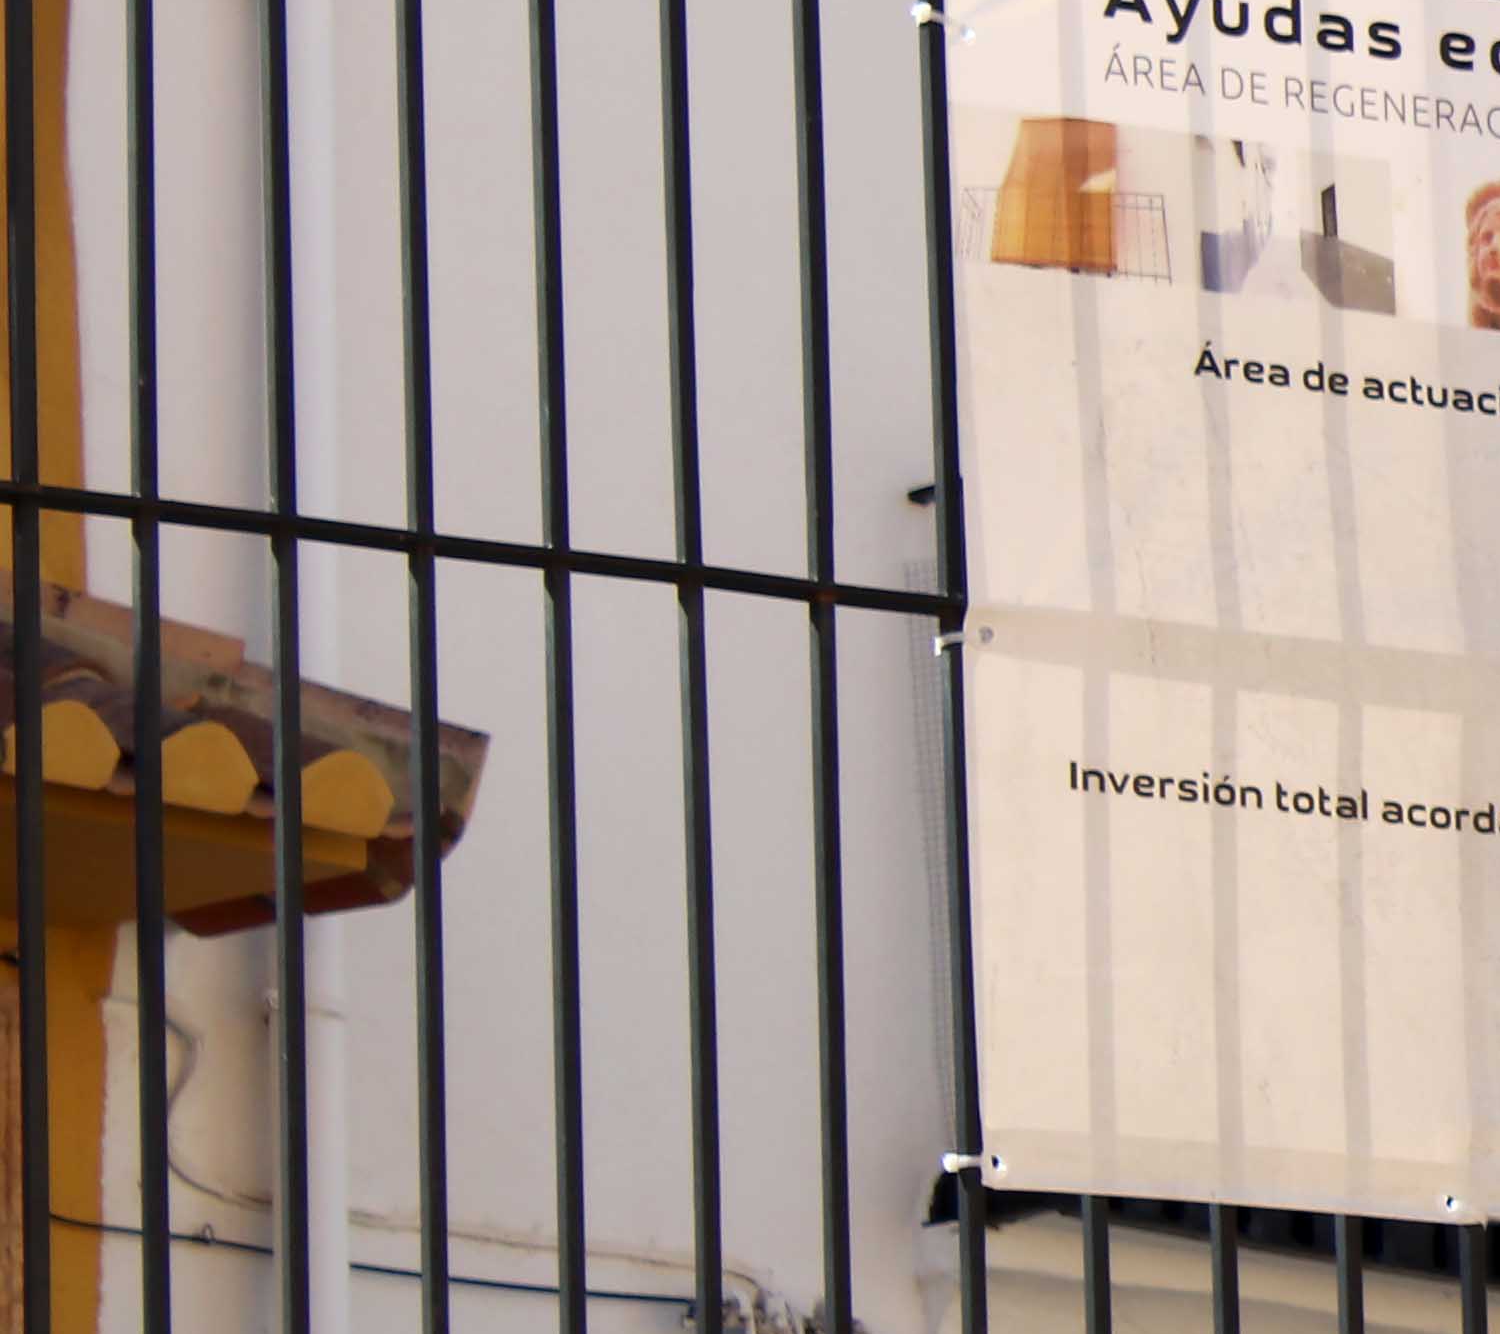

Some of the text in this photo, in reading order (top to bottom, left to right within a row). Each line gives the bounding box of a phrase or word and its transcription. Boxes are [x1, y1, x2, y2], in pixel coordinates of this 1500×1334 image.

[1104, 42, 1206, 96] ÁREA
[1220, 67, 1270, 106] DE
[1194, 340, 1291, 387] Área
[1302, 361, 1350, 396] de
[1068, 760, 1264, 811] Inversión
[1274, 781, 1369, 821] total
